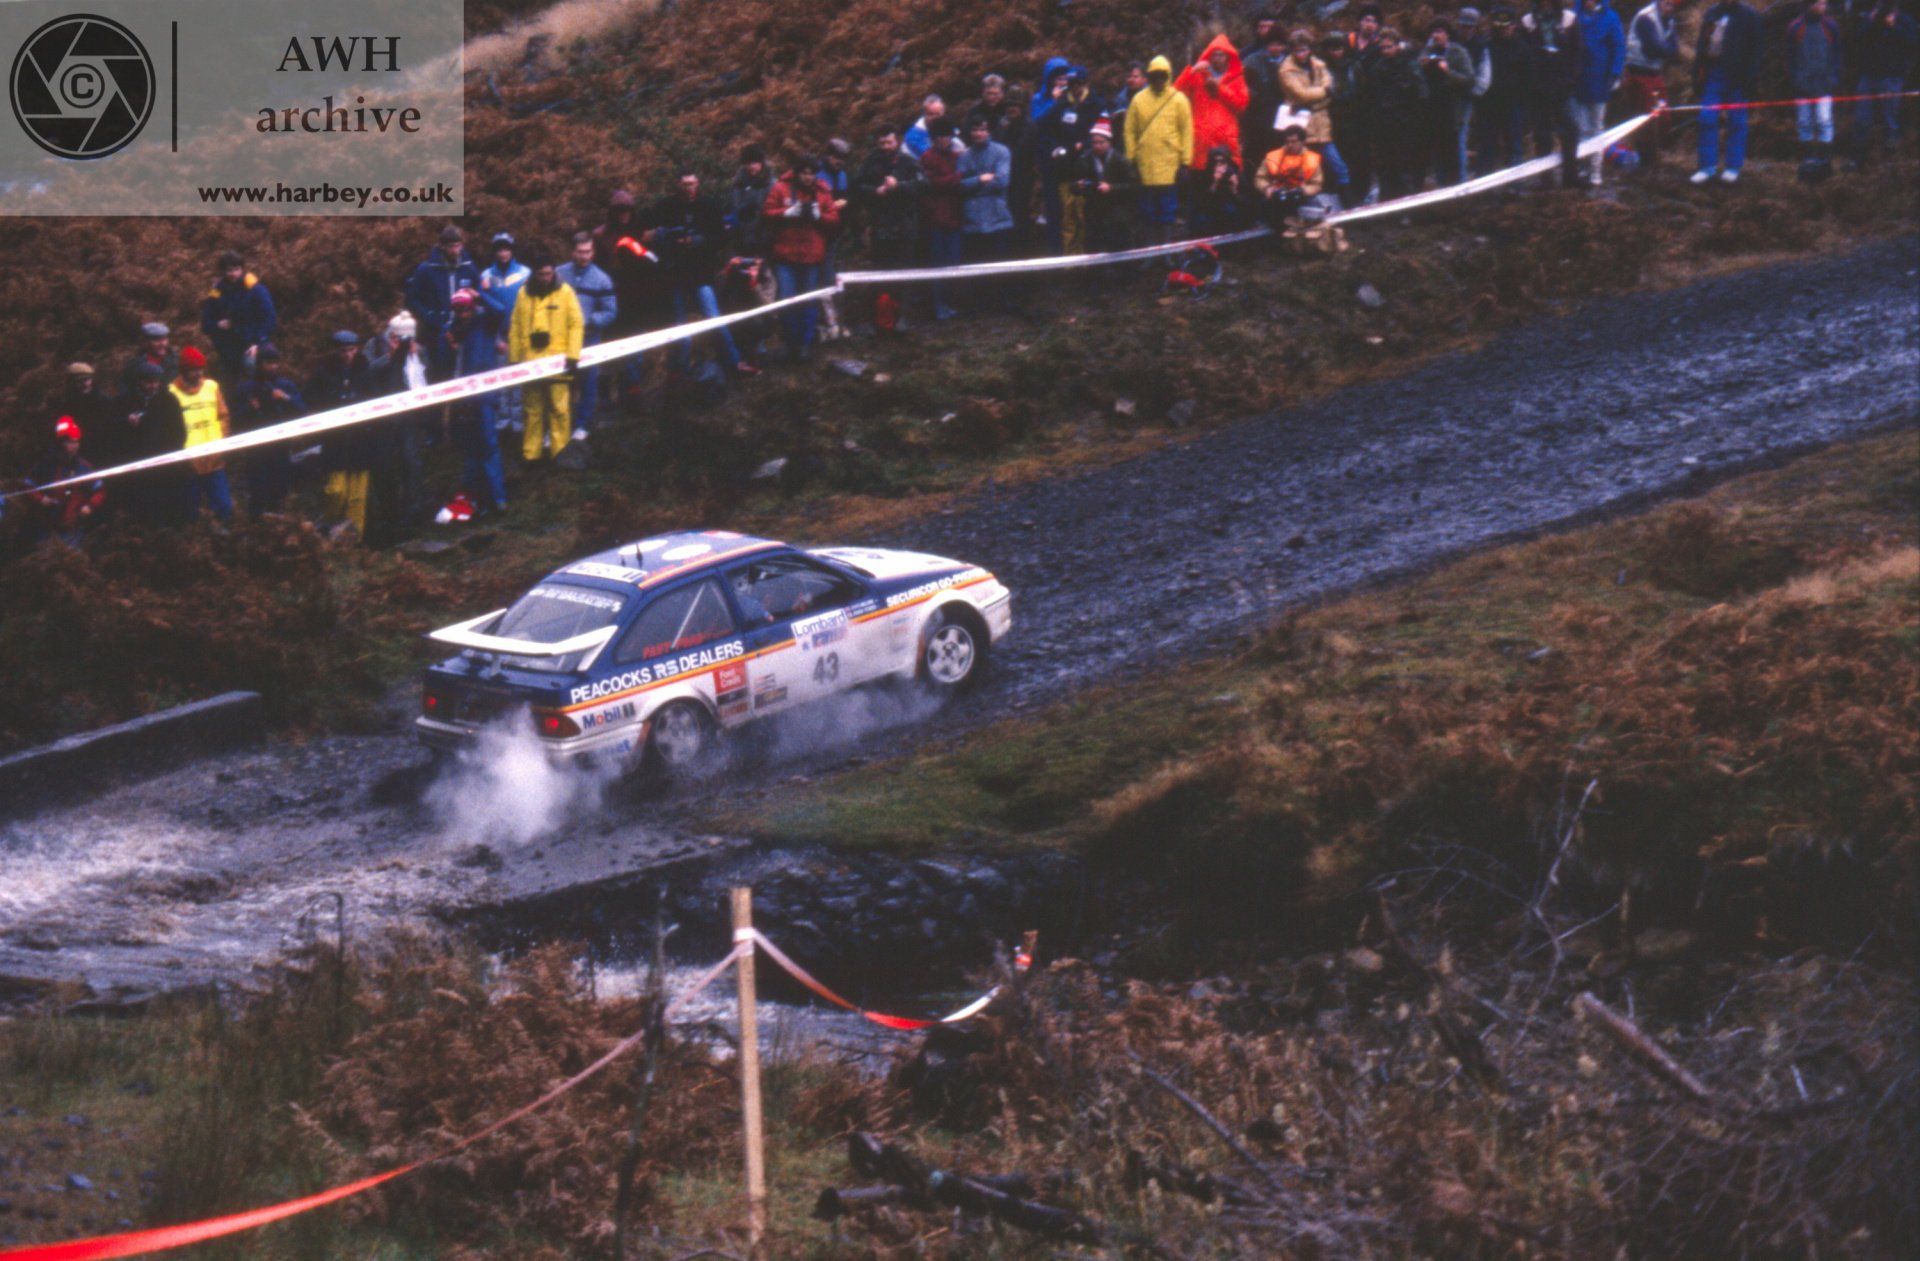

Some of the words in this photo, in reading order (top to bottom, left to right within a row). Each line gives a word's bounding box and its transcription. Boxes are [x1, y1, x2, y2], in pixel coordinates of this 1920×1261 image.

[793, 610, 847, 638] Lombard
[570, 668, 652, 704] PEACOCKS
[653, 659, 679, 680] RS
[679, 640, 745, 670] DEALERS
[812, 651, 840, 684] 43
[582, 706, 621, 729] Mobil
